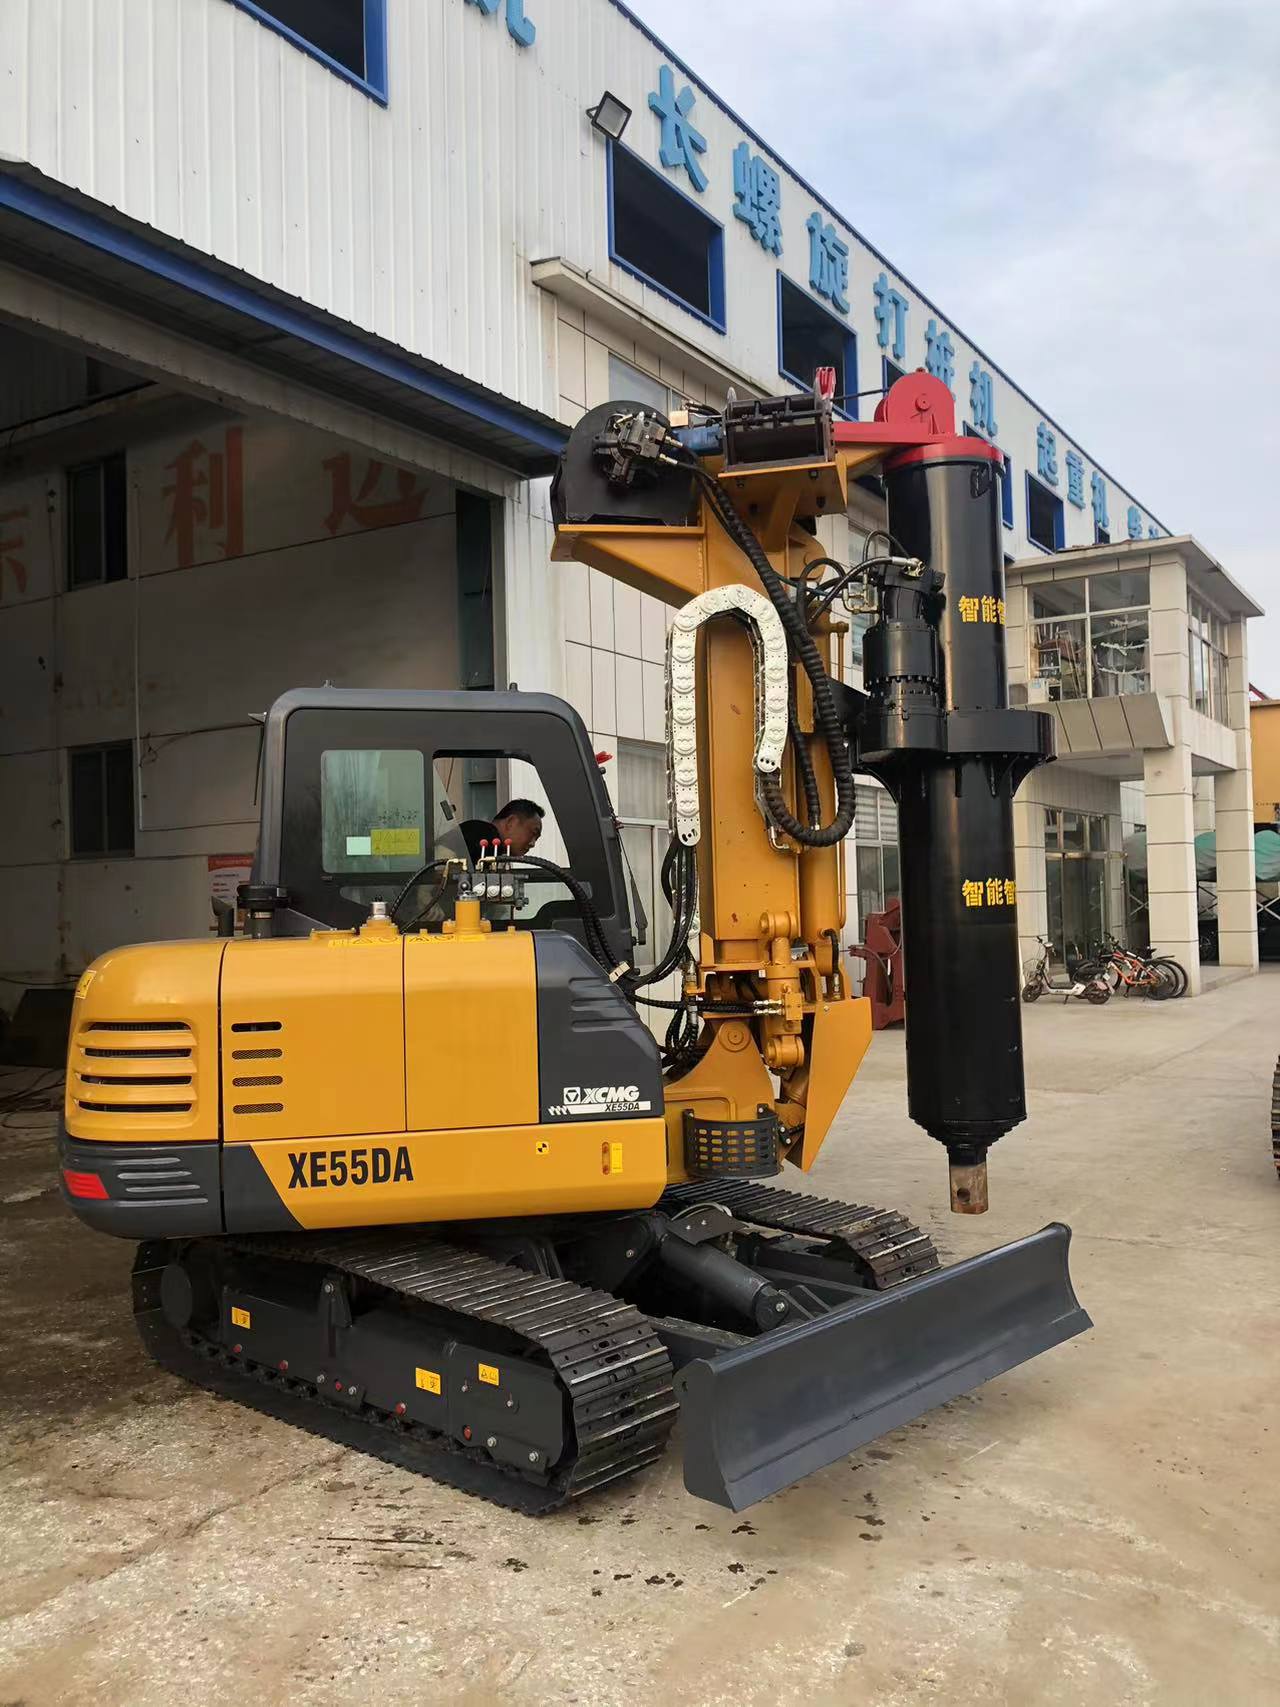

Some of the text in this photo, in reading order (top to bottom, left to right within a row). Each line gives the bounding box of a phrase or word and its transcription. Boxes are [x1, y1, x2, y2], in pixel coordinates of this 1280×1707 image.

[582, 1086, 640, 1104] XCMG
[604, 1102, 640, 1112] XE55DA
[288, 1146, 414, 1189] XE55DA
